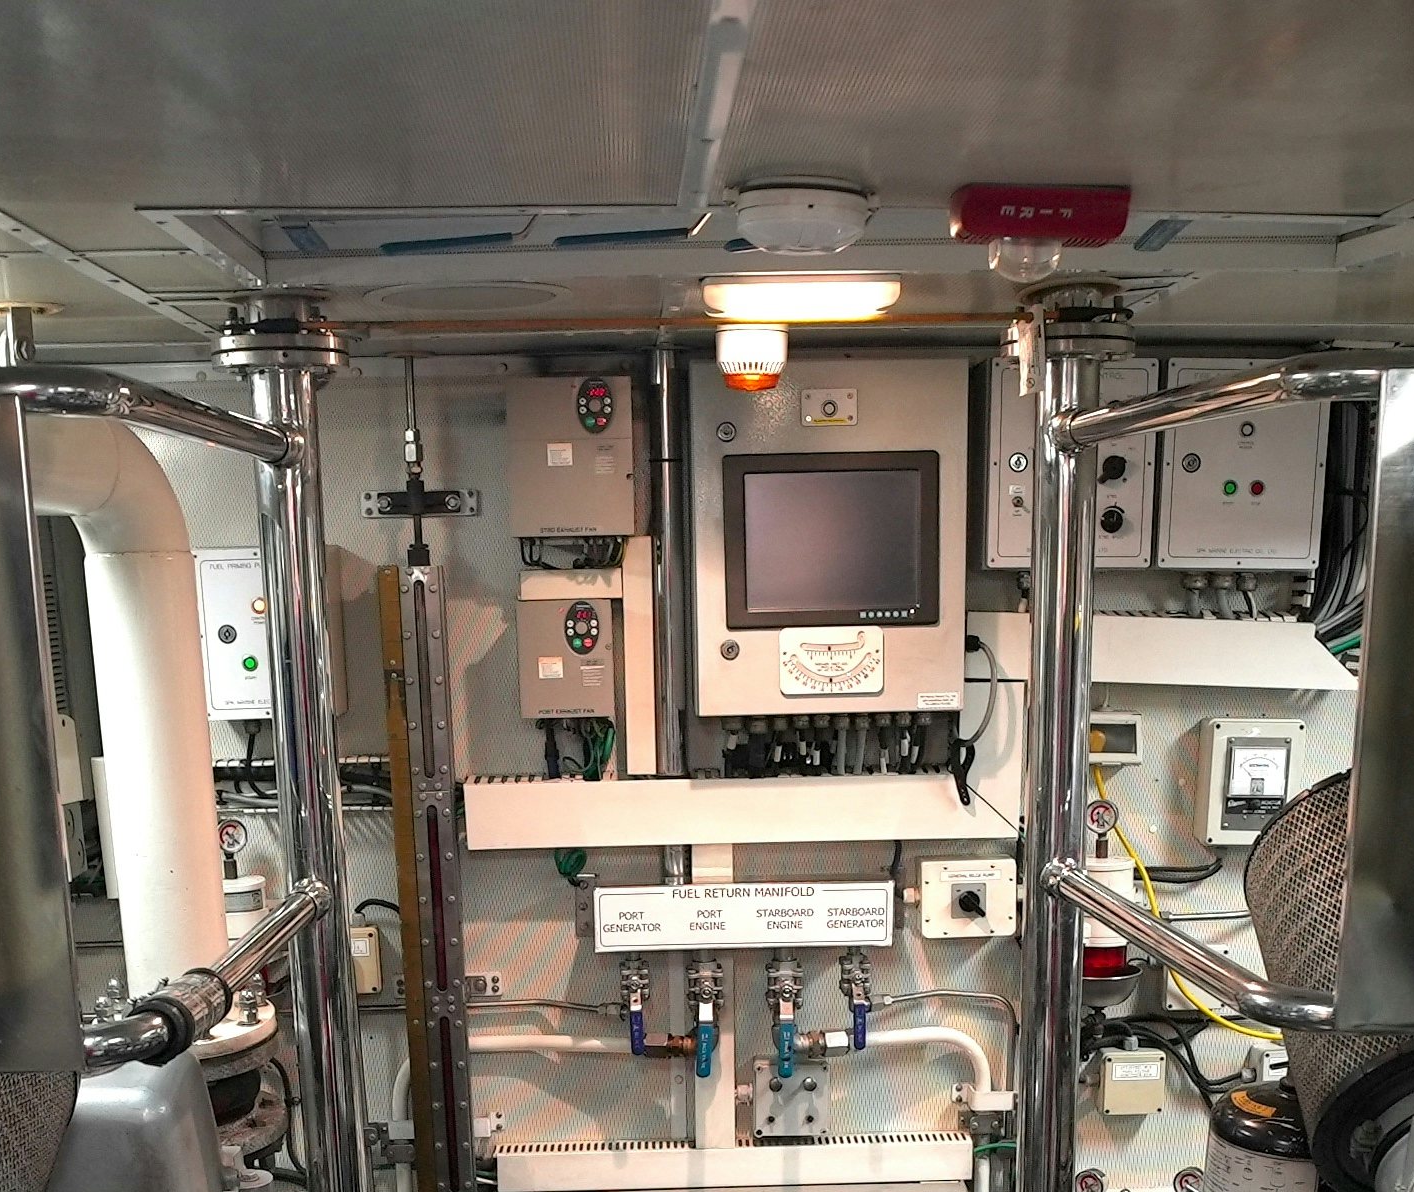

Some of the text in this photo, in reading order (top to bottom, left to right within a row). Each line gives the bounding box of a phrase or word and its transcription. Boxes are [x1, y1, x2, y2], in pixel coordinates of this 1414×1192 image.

[1000, 205, 1073, 219] FIRE
[672, 886, 815, 900] FUEL RETURN MANIFOLD
[619, 911, 645, 921] PORT
[697, 909, 723, 919] PORT
[756, 908, 814, 918] STARBOARD
[827, 907, 885, 917] STARBOARD
[603, 922, 662, 933] GENERATOR
[689, 921, 726, 931] ENGINE
[767, 920, 803, 930] ENGINE
[826, 918, 885, 929] GENERATOR
